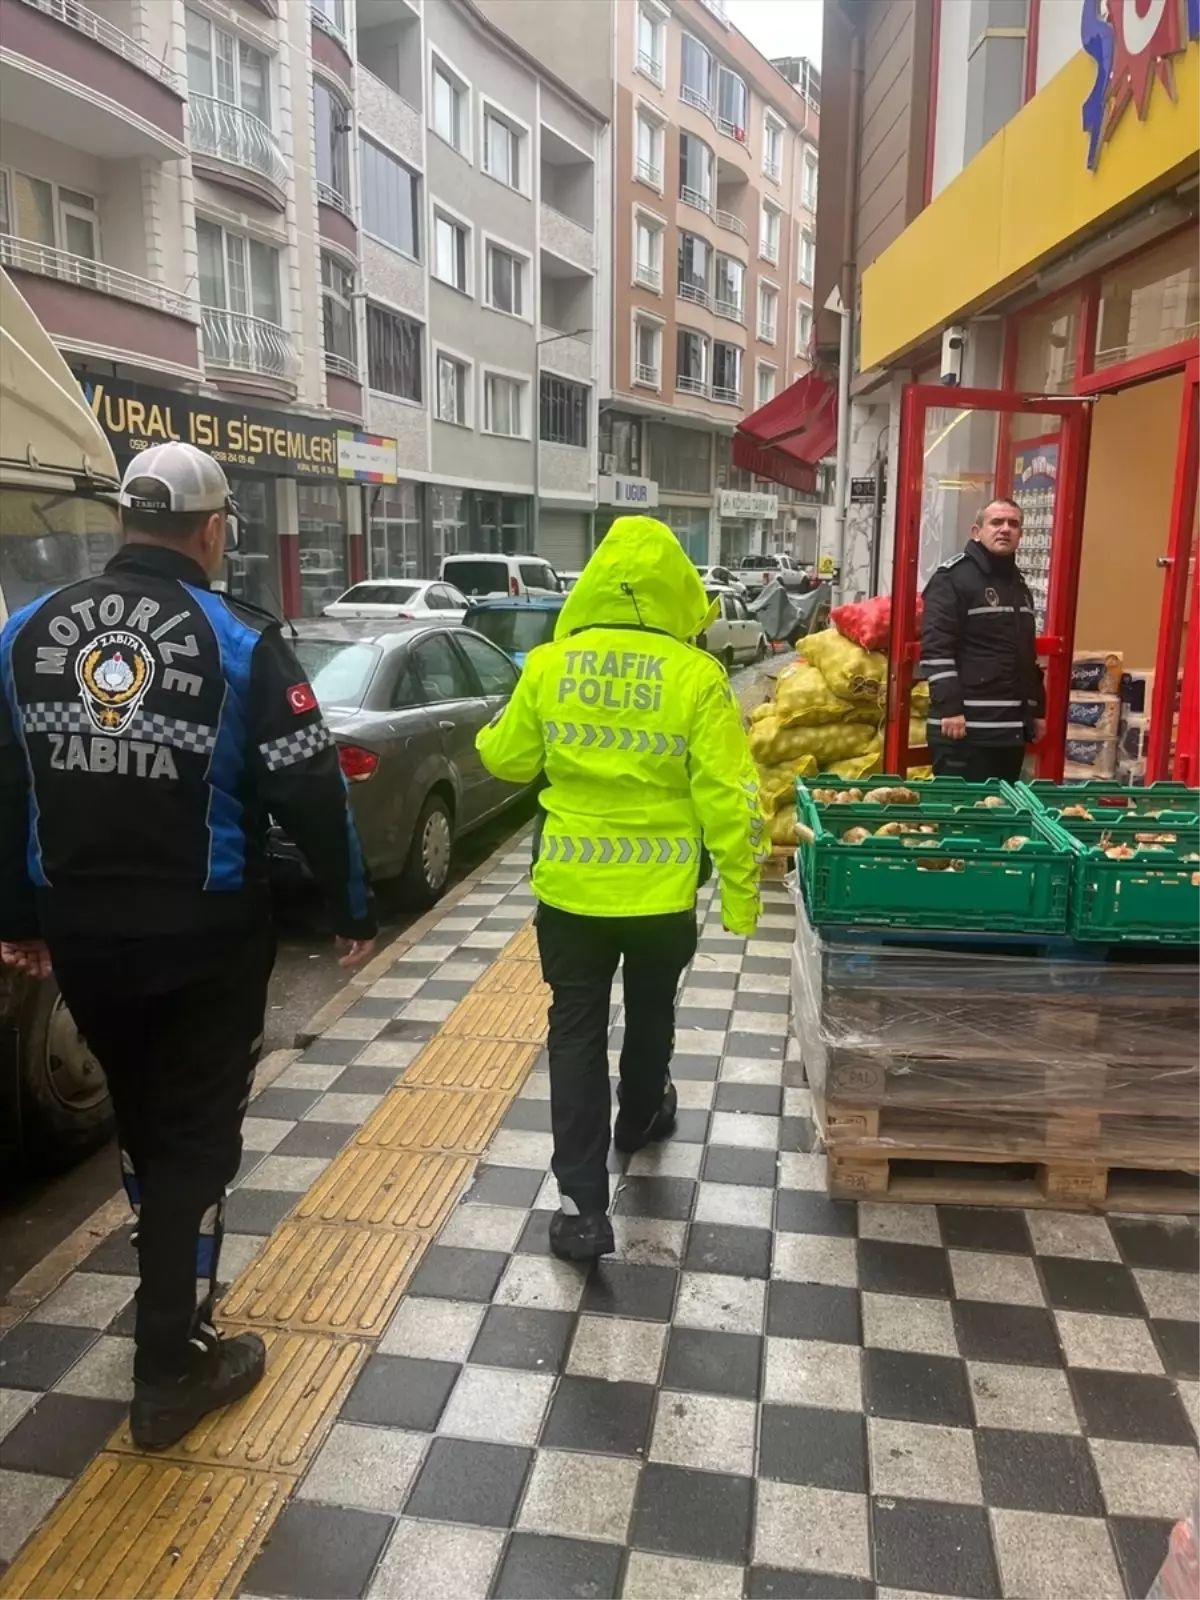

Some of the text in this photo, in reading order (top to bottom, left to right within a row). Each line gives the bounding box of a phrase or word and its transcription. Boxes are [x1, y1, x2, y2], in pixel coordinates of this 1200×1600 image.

[189, 411, 219, 447] ISI
[227, 414, 337, 464] SİSTEMLERİ
[35, 594, 203, 696] MOTORİZE
[100, 634, 139, 651] ZABITA
[47, 733, 179, 780] ZABITA
